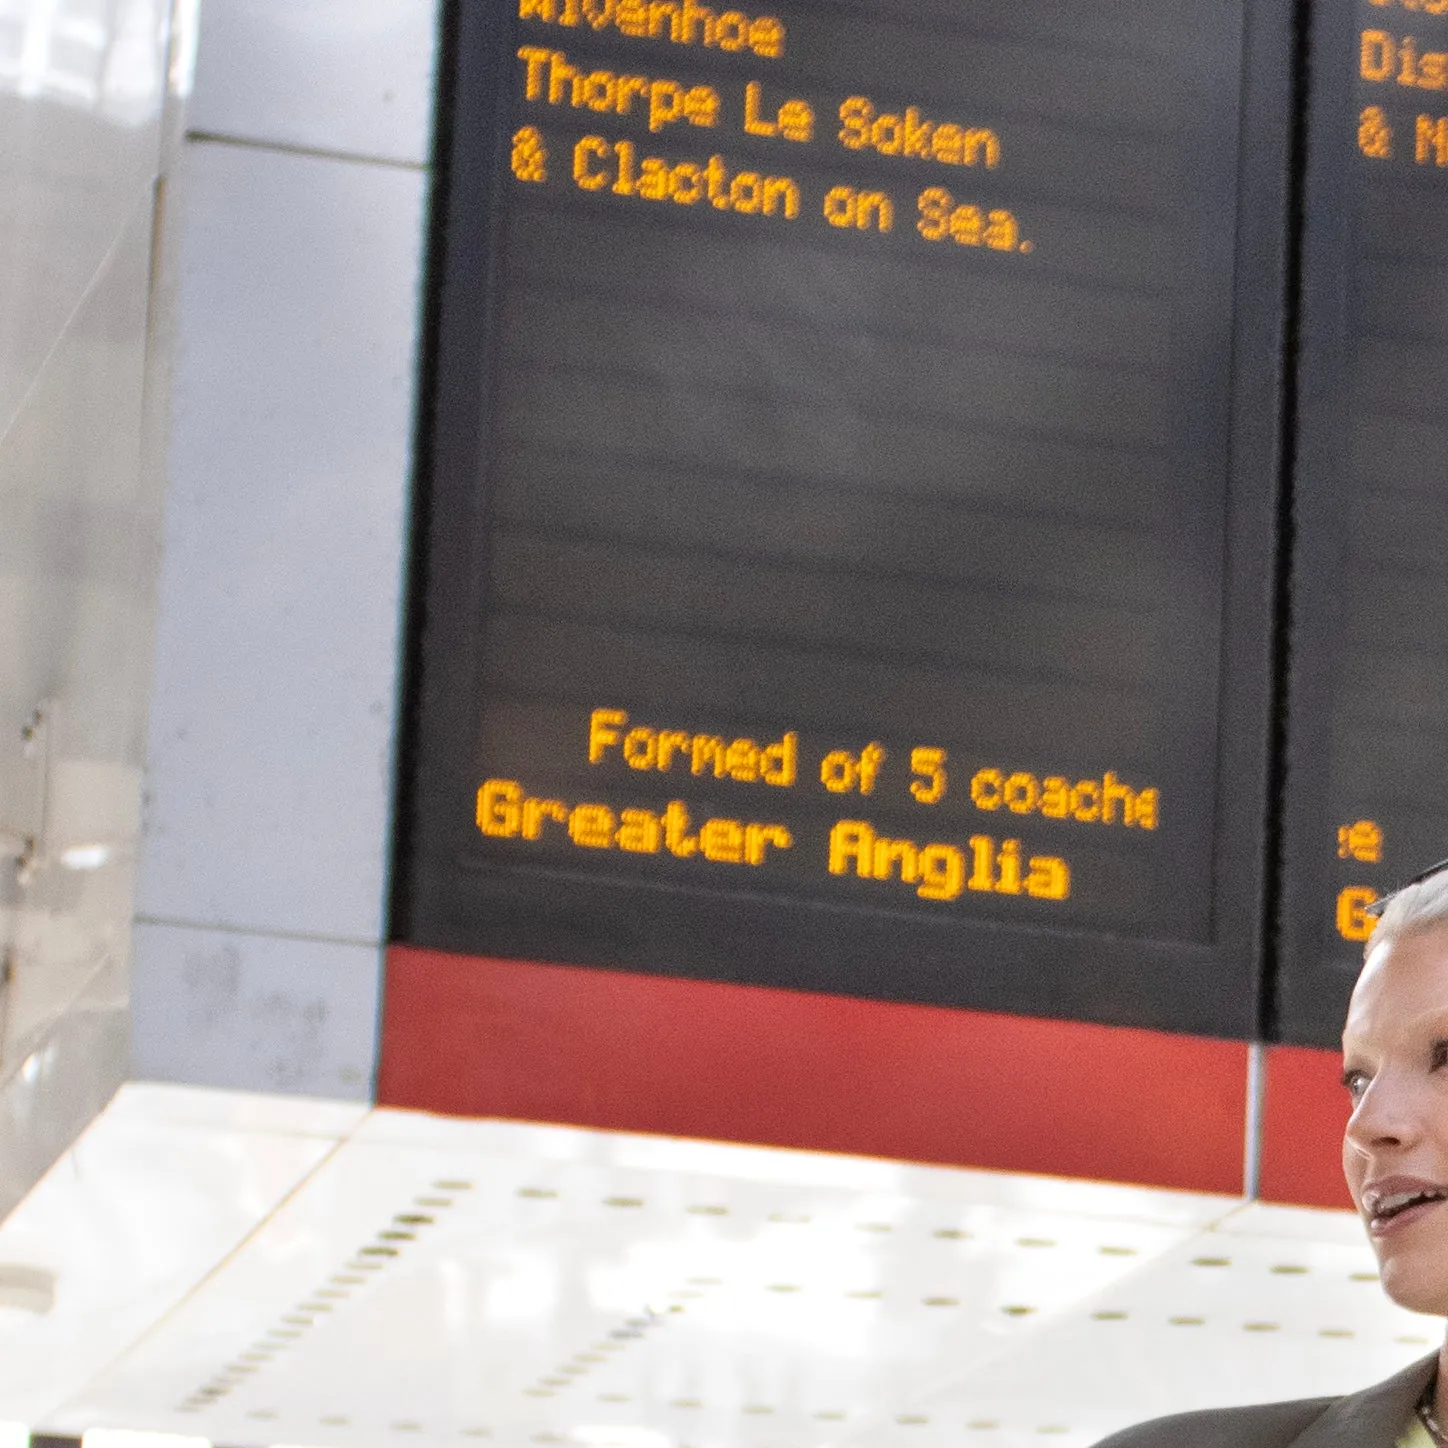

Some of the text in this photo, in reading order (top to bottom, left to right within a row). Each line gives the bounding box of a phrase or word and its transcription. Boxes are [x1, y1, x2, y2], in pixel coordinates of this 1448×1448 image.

[517, 46, 999, 168] Thorpe Le Soken
[1357, 105, 1391, 158] &
[511, 126, 1034, 253] & Clacton on Sea.
[588, 709, 797, 787] Formed
[819, 742, 884, 795] of
[909, 746, 947, 804] 5
[475, 778, 1070, 901] Greater Anglia
